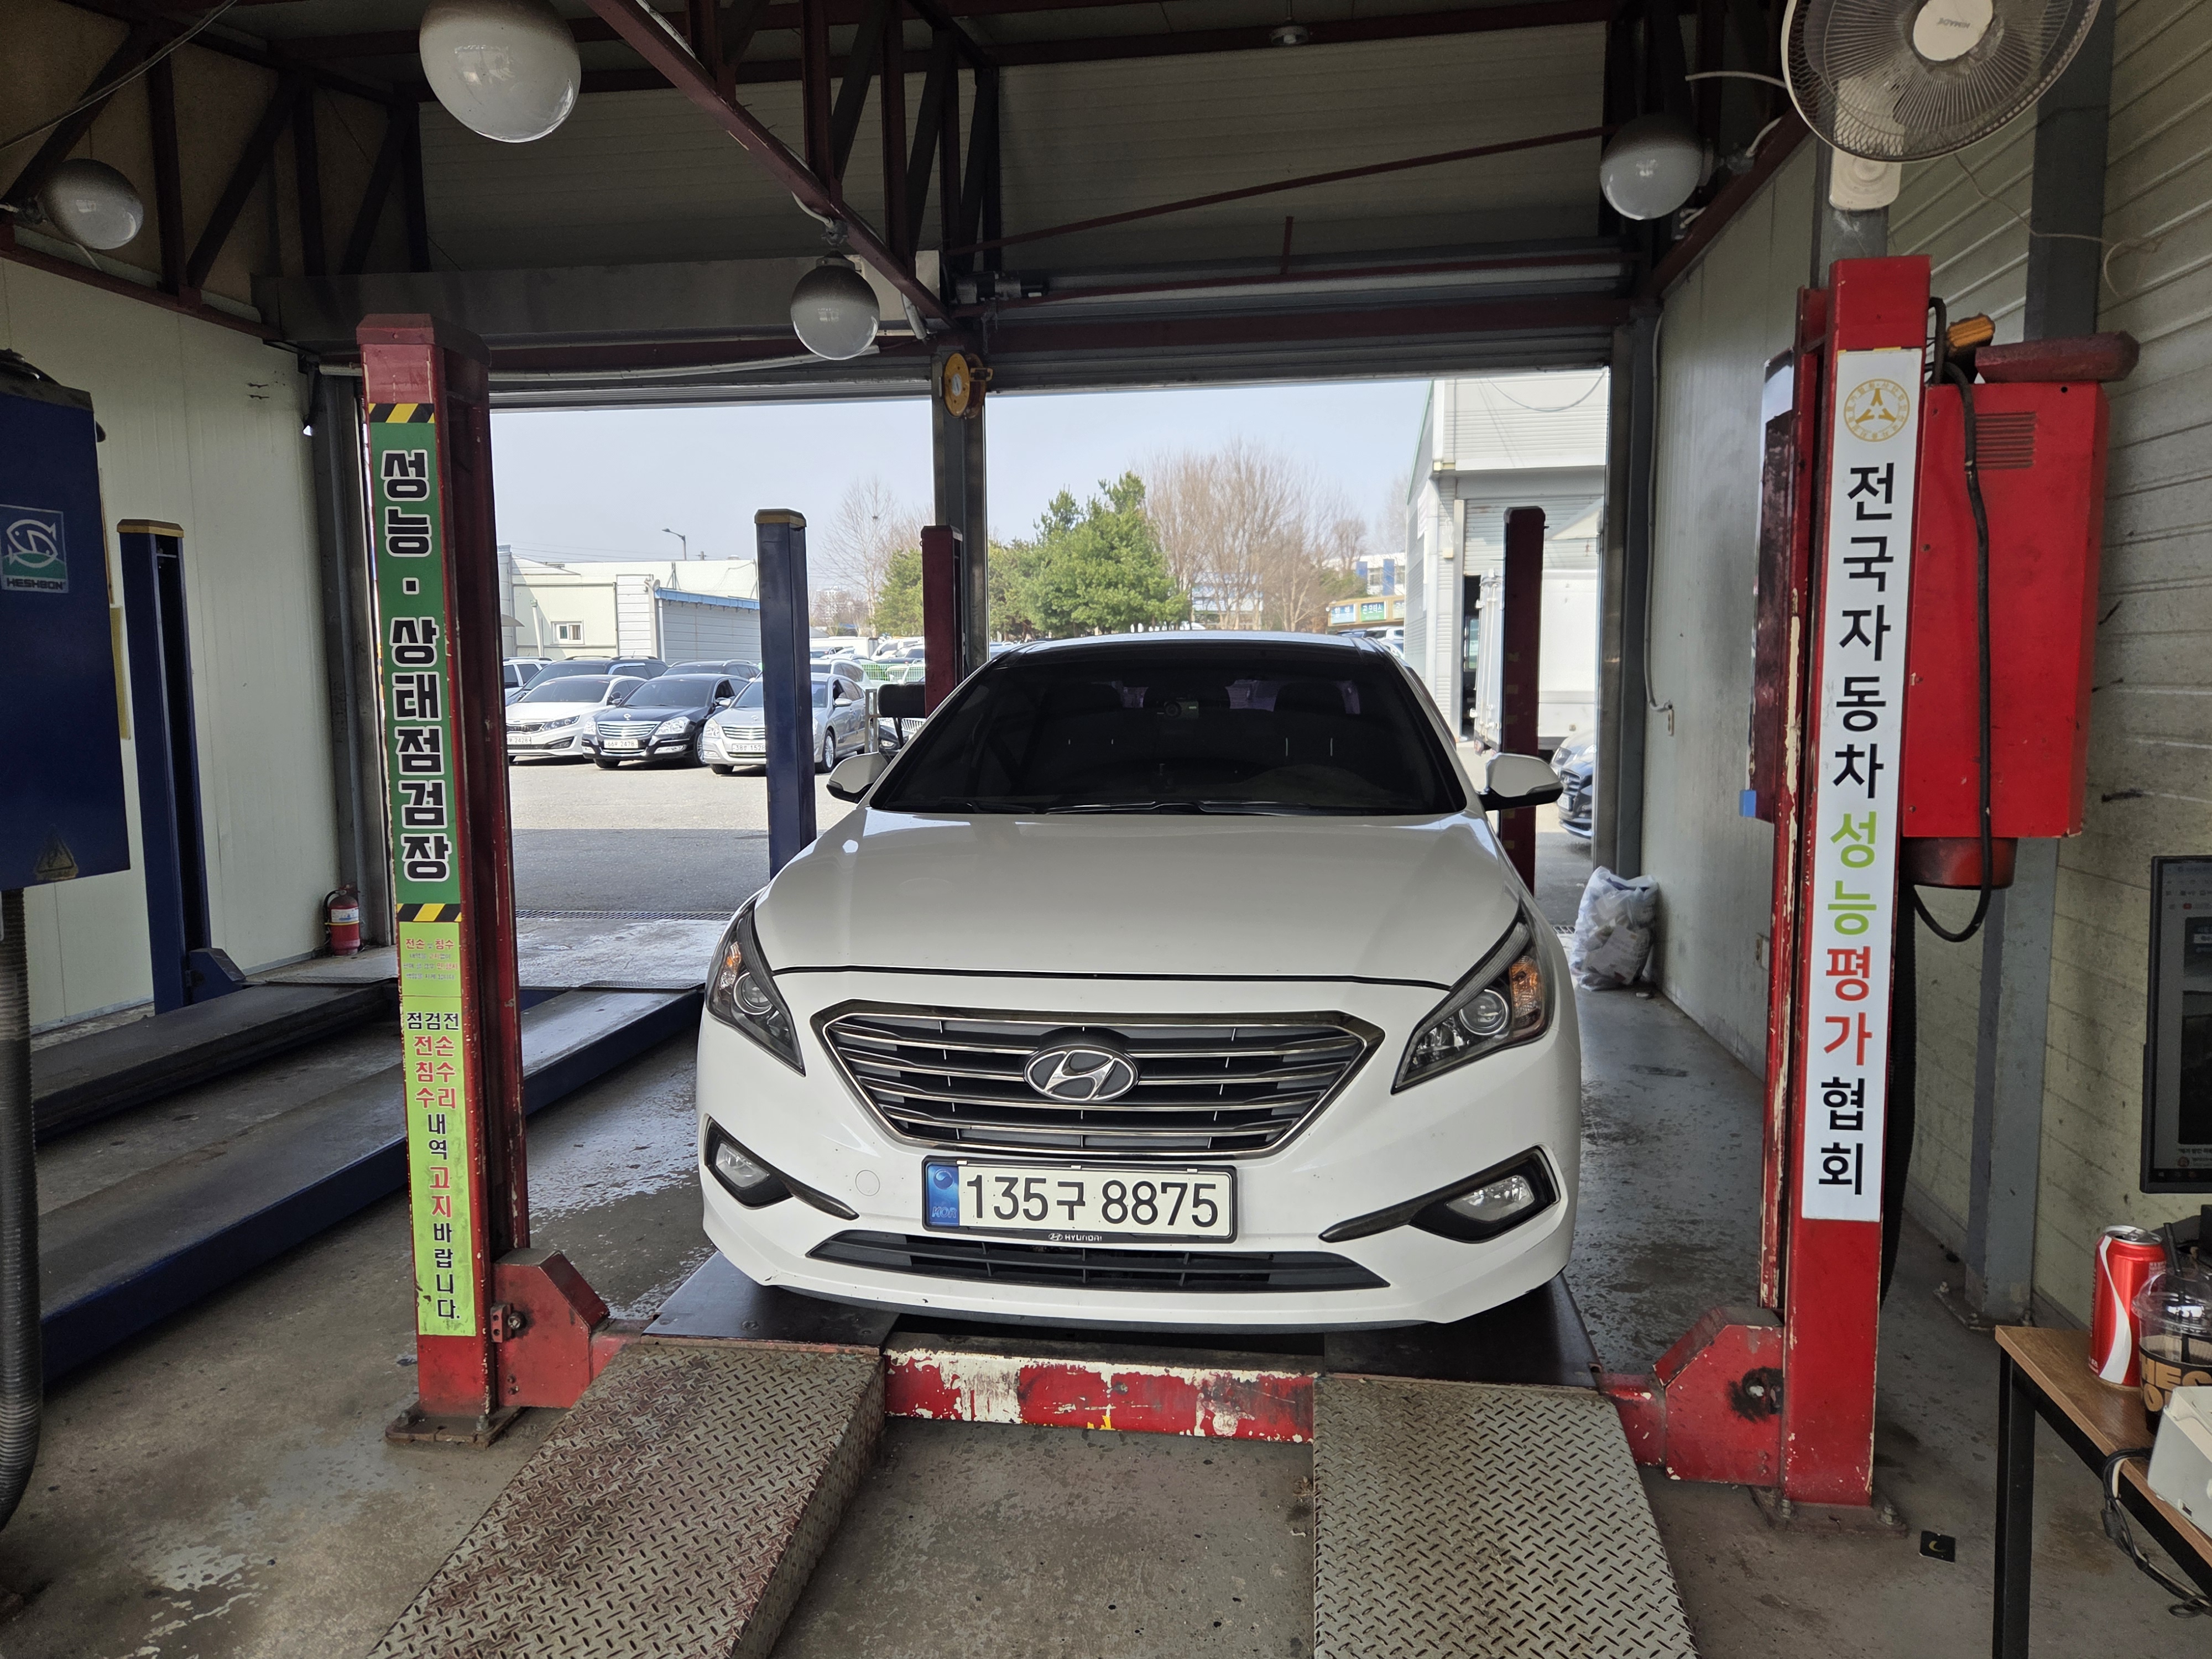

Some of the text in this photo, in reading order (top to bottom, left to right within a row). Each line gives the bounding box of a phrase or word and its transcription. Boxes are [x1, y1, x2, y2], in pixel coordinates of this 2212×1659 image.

[7, 577, 64, 591] HESHBON
[405, 938, 425, 950] 전손
[435, 938, 454, 950] 침수
[406, 1012, 460, 1030] 점검전
[414, 1035, 455, 1057] 전손
[414, 1062, 456, 1083] 침수
[414, 1087, 457, 1109] 수리
[967, 1175, 1218, 1228] 135구 8875
[931, 1206, 957, 1218] KOR
[1065, 1233, 1102, 1242] HYUNDAI
